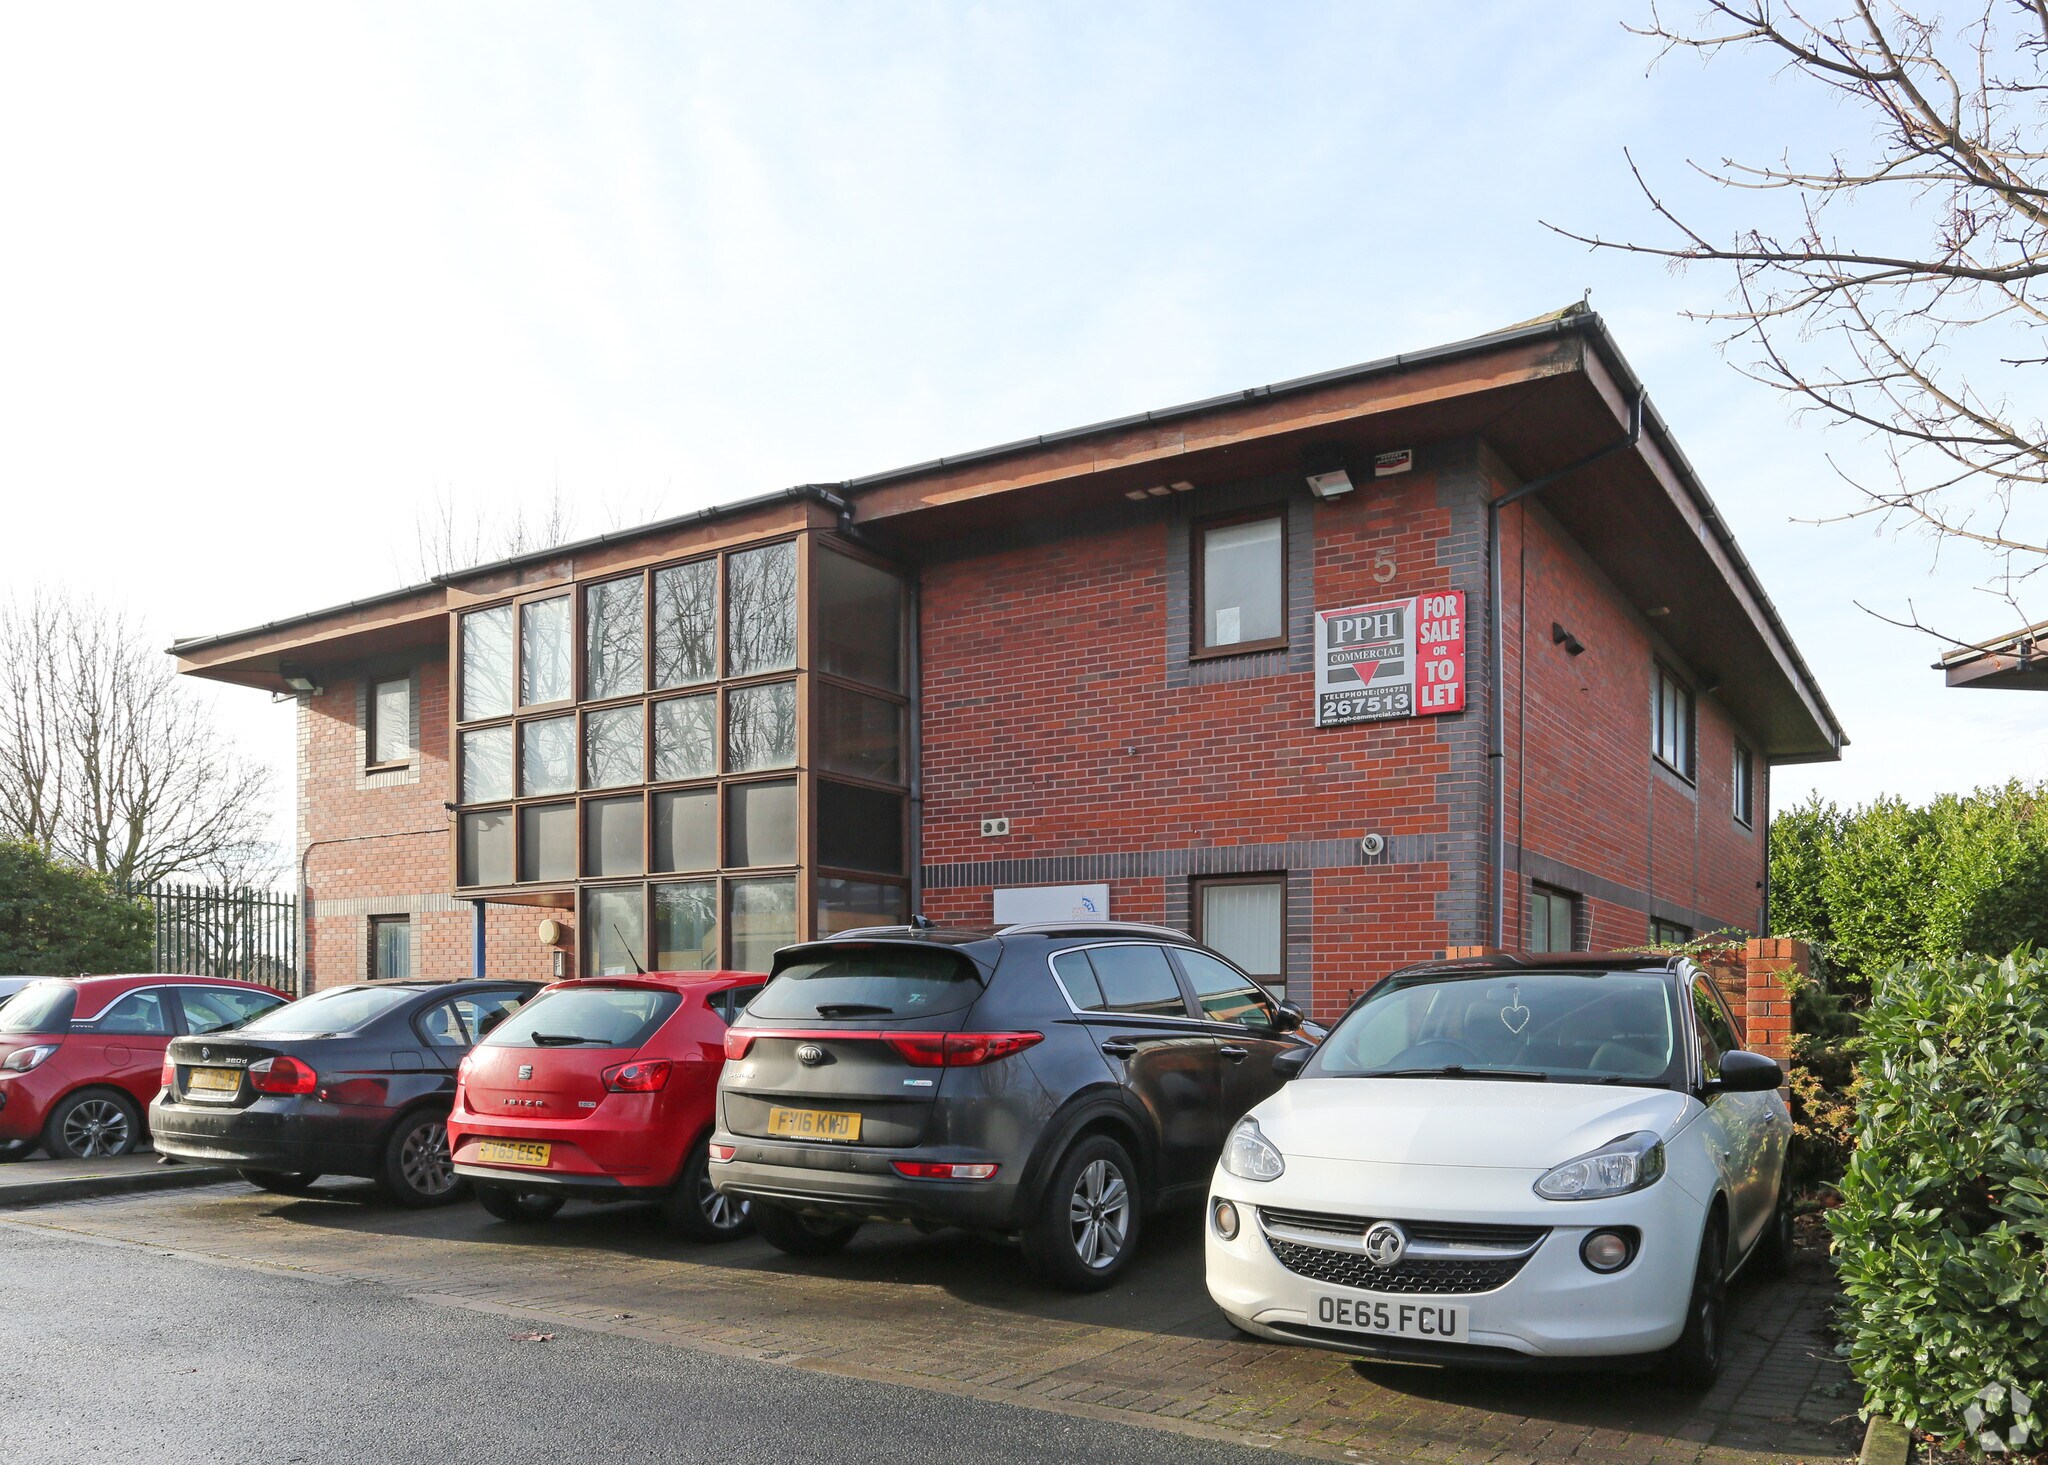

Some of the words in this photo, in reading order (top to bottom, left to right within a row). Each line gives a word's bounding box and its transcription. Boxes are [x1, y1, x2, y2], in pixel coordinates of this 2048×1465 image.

[1373, 548, 1397, 583] 5
[1423, 595, 1457, 620] FOR
[1334, 612, 1396, 644] PPH
[1420, 618, 1460, 644] SALE
[1330, 646, 1401, 663] COMMERCIAL
[1433, 646, 1447, 656] OR
[1424, 659, 1455, 683] TO
[1323, 693, 1409, 717] 267513
[1421, 682, 1459, 707] LET
[1321, 709, 1411, 724] www.pph-commercial.co.uk
[801, 1049, 818, 1060] KIA
[503, 1098, 544, 1107] IBIZA
[777, 1111, 813, 1133] FY16
[816, 1113, 849, 1135] KWD
[483, 1141, 514, 1161] FY65
[517, 1144, 545, 1162] EES
[1318, 1296, 1390, 1330] OE65
[1399, 1304, 1456, 1337] FCU
